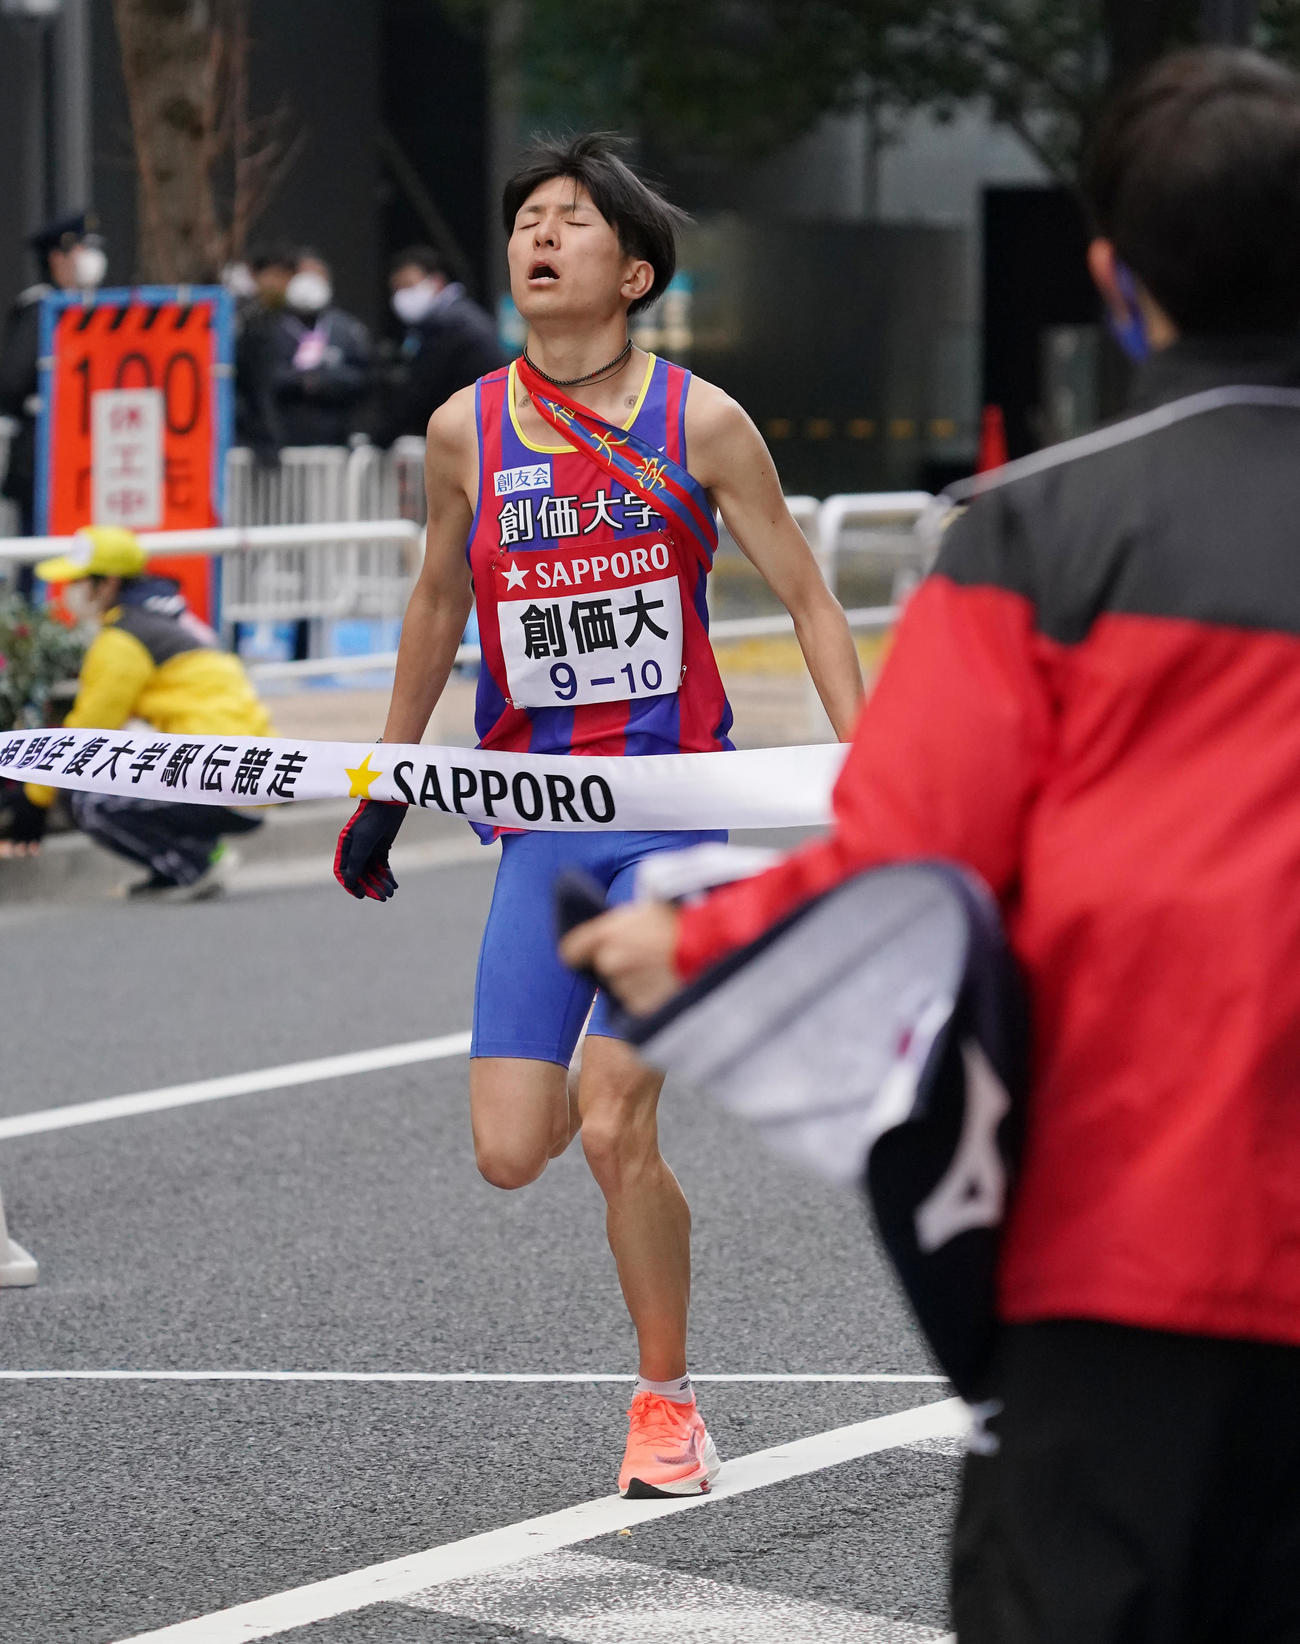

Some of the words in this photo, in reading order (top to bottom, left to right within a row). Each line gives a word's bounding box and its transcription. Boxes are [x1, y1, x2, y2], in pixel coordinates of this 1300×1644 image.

[496, 467, 551, 494] 創友会
[498, 489, 665, 548] 創価大学
[535, 543, 671, 589] SAPPORO
[519, 589, 669, 660] 創価大
[391, 760, 616, 824] SAPPORO
